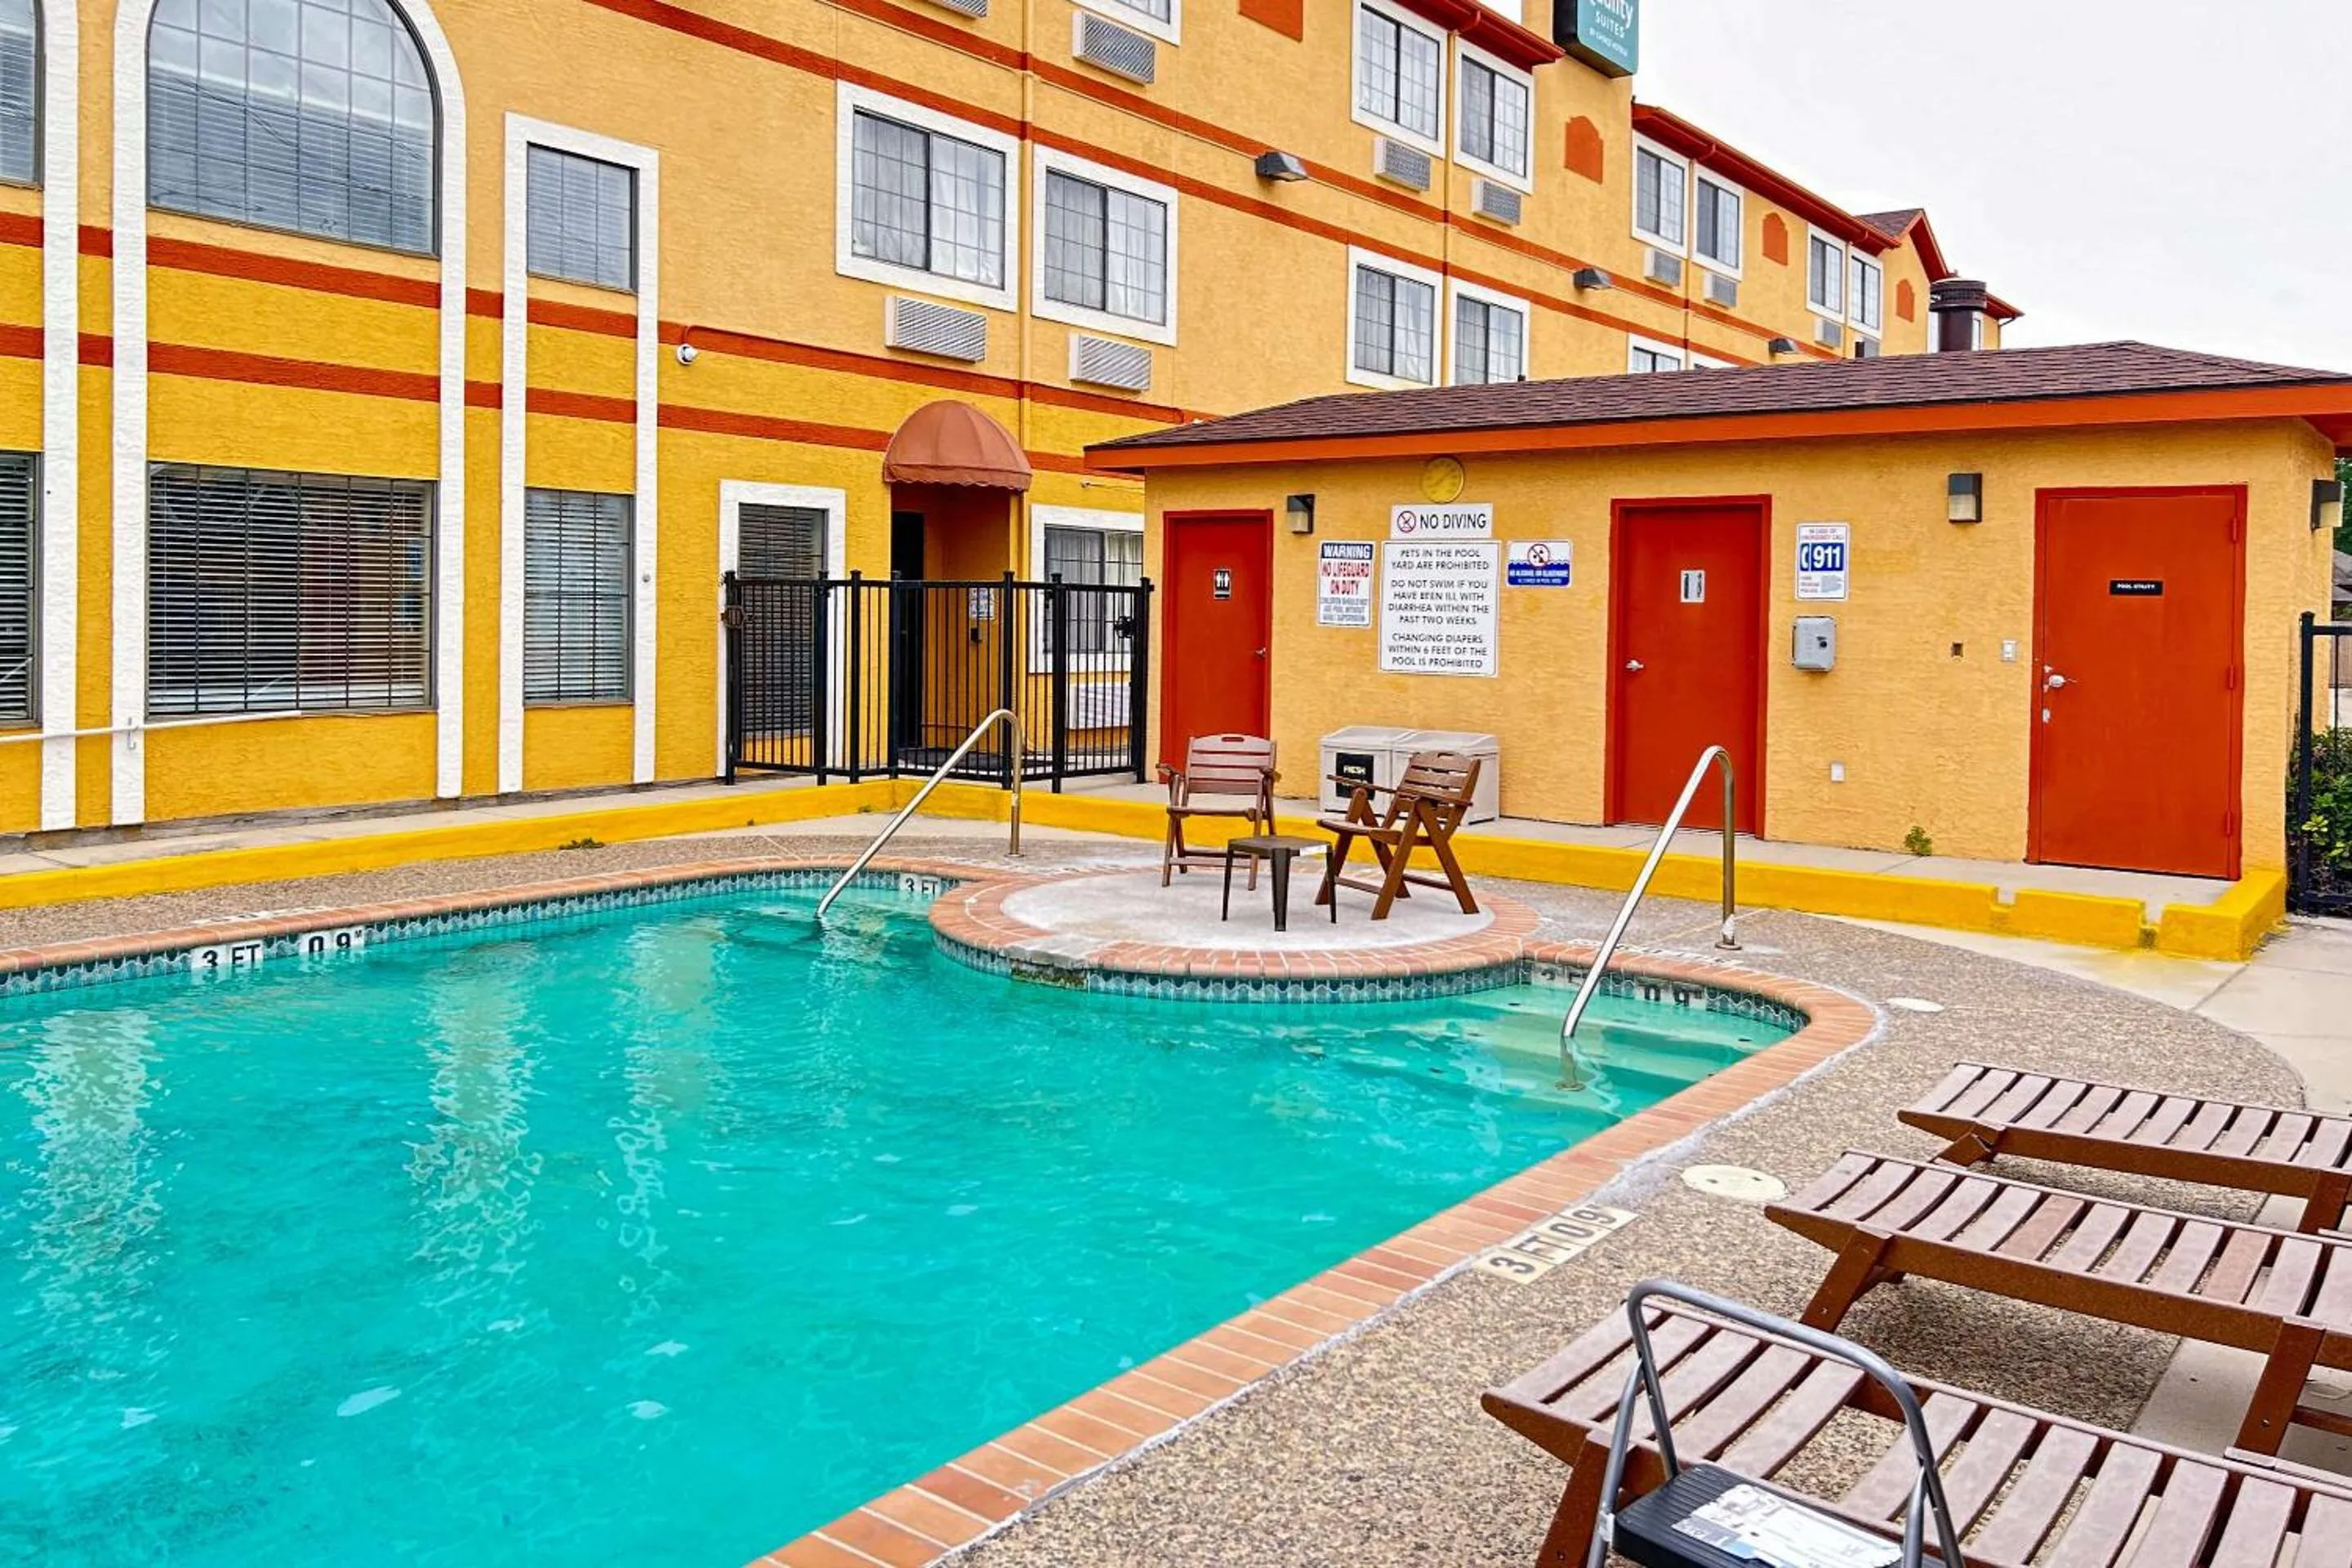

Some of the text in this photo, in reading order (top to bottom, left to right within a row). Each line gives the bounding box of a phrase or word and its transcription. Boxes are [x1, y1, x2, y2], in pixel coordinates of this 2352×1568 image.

[1594, 10, 1625, 38] SUITES
[1420, 514, 1486, 529] NO DIVING
[1323, 545, 1371, 559] WARNING
[1401, 549, 1481, 558] PETS IN THE POOL
[1813, 545, 1841, 569] 911
[1321, 561, 1370, 578] NO LIFEGUARD
[1391, 561, 1490, 570] YARD ARE PROHIBITED
[1330, 580, 1360, 595] ON DUTY
[1391, 580, 1488, 589] DO NOT SWIM IF YOU
[1393, 591, 1485, 601] HAVE BEEN ILL WITH
[1388, 603, 1490, 613] DIARRHEA WITHIN THE
[1400, 615, 1477, 625] PAST TWO WEEKS
[1392, 633, 1483, 644] CHANGING DIAPERS
[1388, 644, 1421, 653] WITHIN
[1431, 645, 1452, 654] FEET
[1454, 646, 1468, 655] OF
[1469, 647, 1487, 656] THE
[1392, 656, 1483, 668] POOL IS PROHIBITED
[906, 877, 938, 895] 3 FT
[202, 951, 218, 967] 3
[231, 943, 261, 968] FT
[1512, 1235, 1571, 1260] FT
[1490, 1256, 1537, 1275] 3
